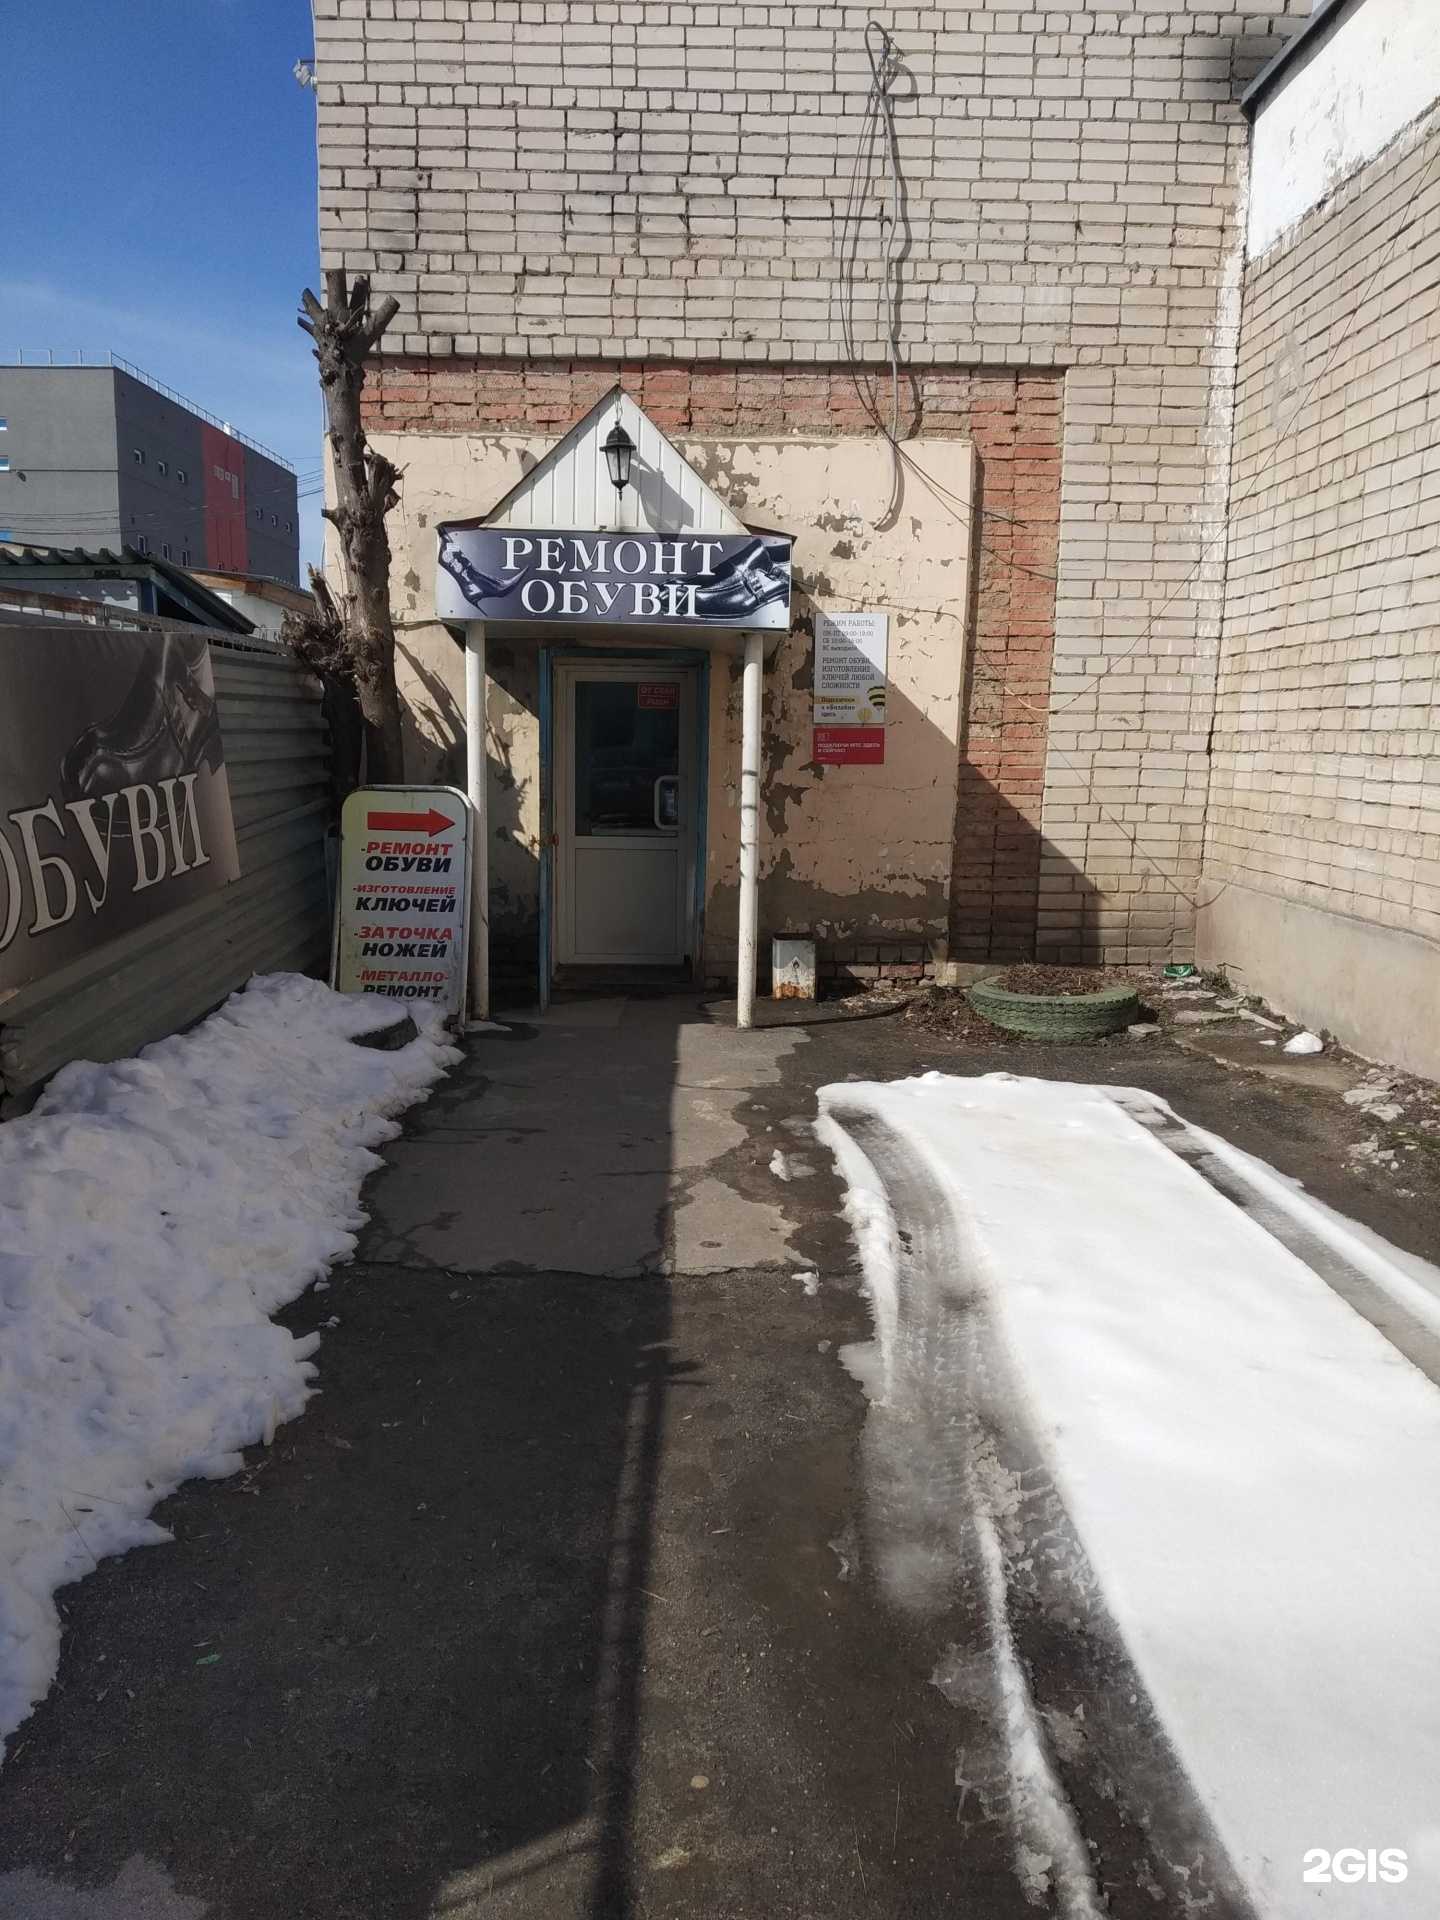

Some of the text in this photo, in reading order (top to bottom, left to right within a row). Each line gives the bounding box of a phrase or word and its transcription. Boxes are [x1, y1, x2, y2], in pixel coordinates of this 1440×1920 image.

[501, 537, 724, 576] РЕМОНТ
[521, 579, 702, 617] ОБУВИ
[365, 856, 452, 872] ОБУВИ
[355, 895, 456, 912] КЛЮЧЕЙ
[361, 940, 448, 958] НОЖЕЙ
[363, 984, 443, 998] РЕМОНТ
